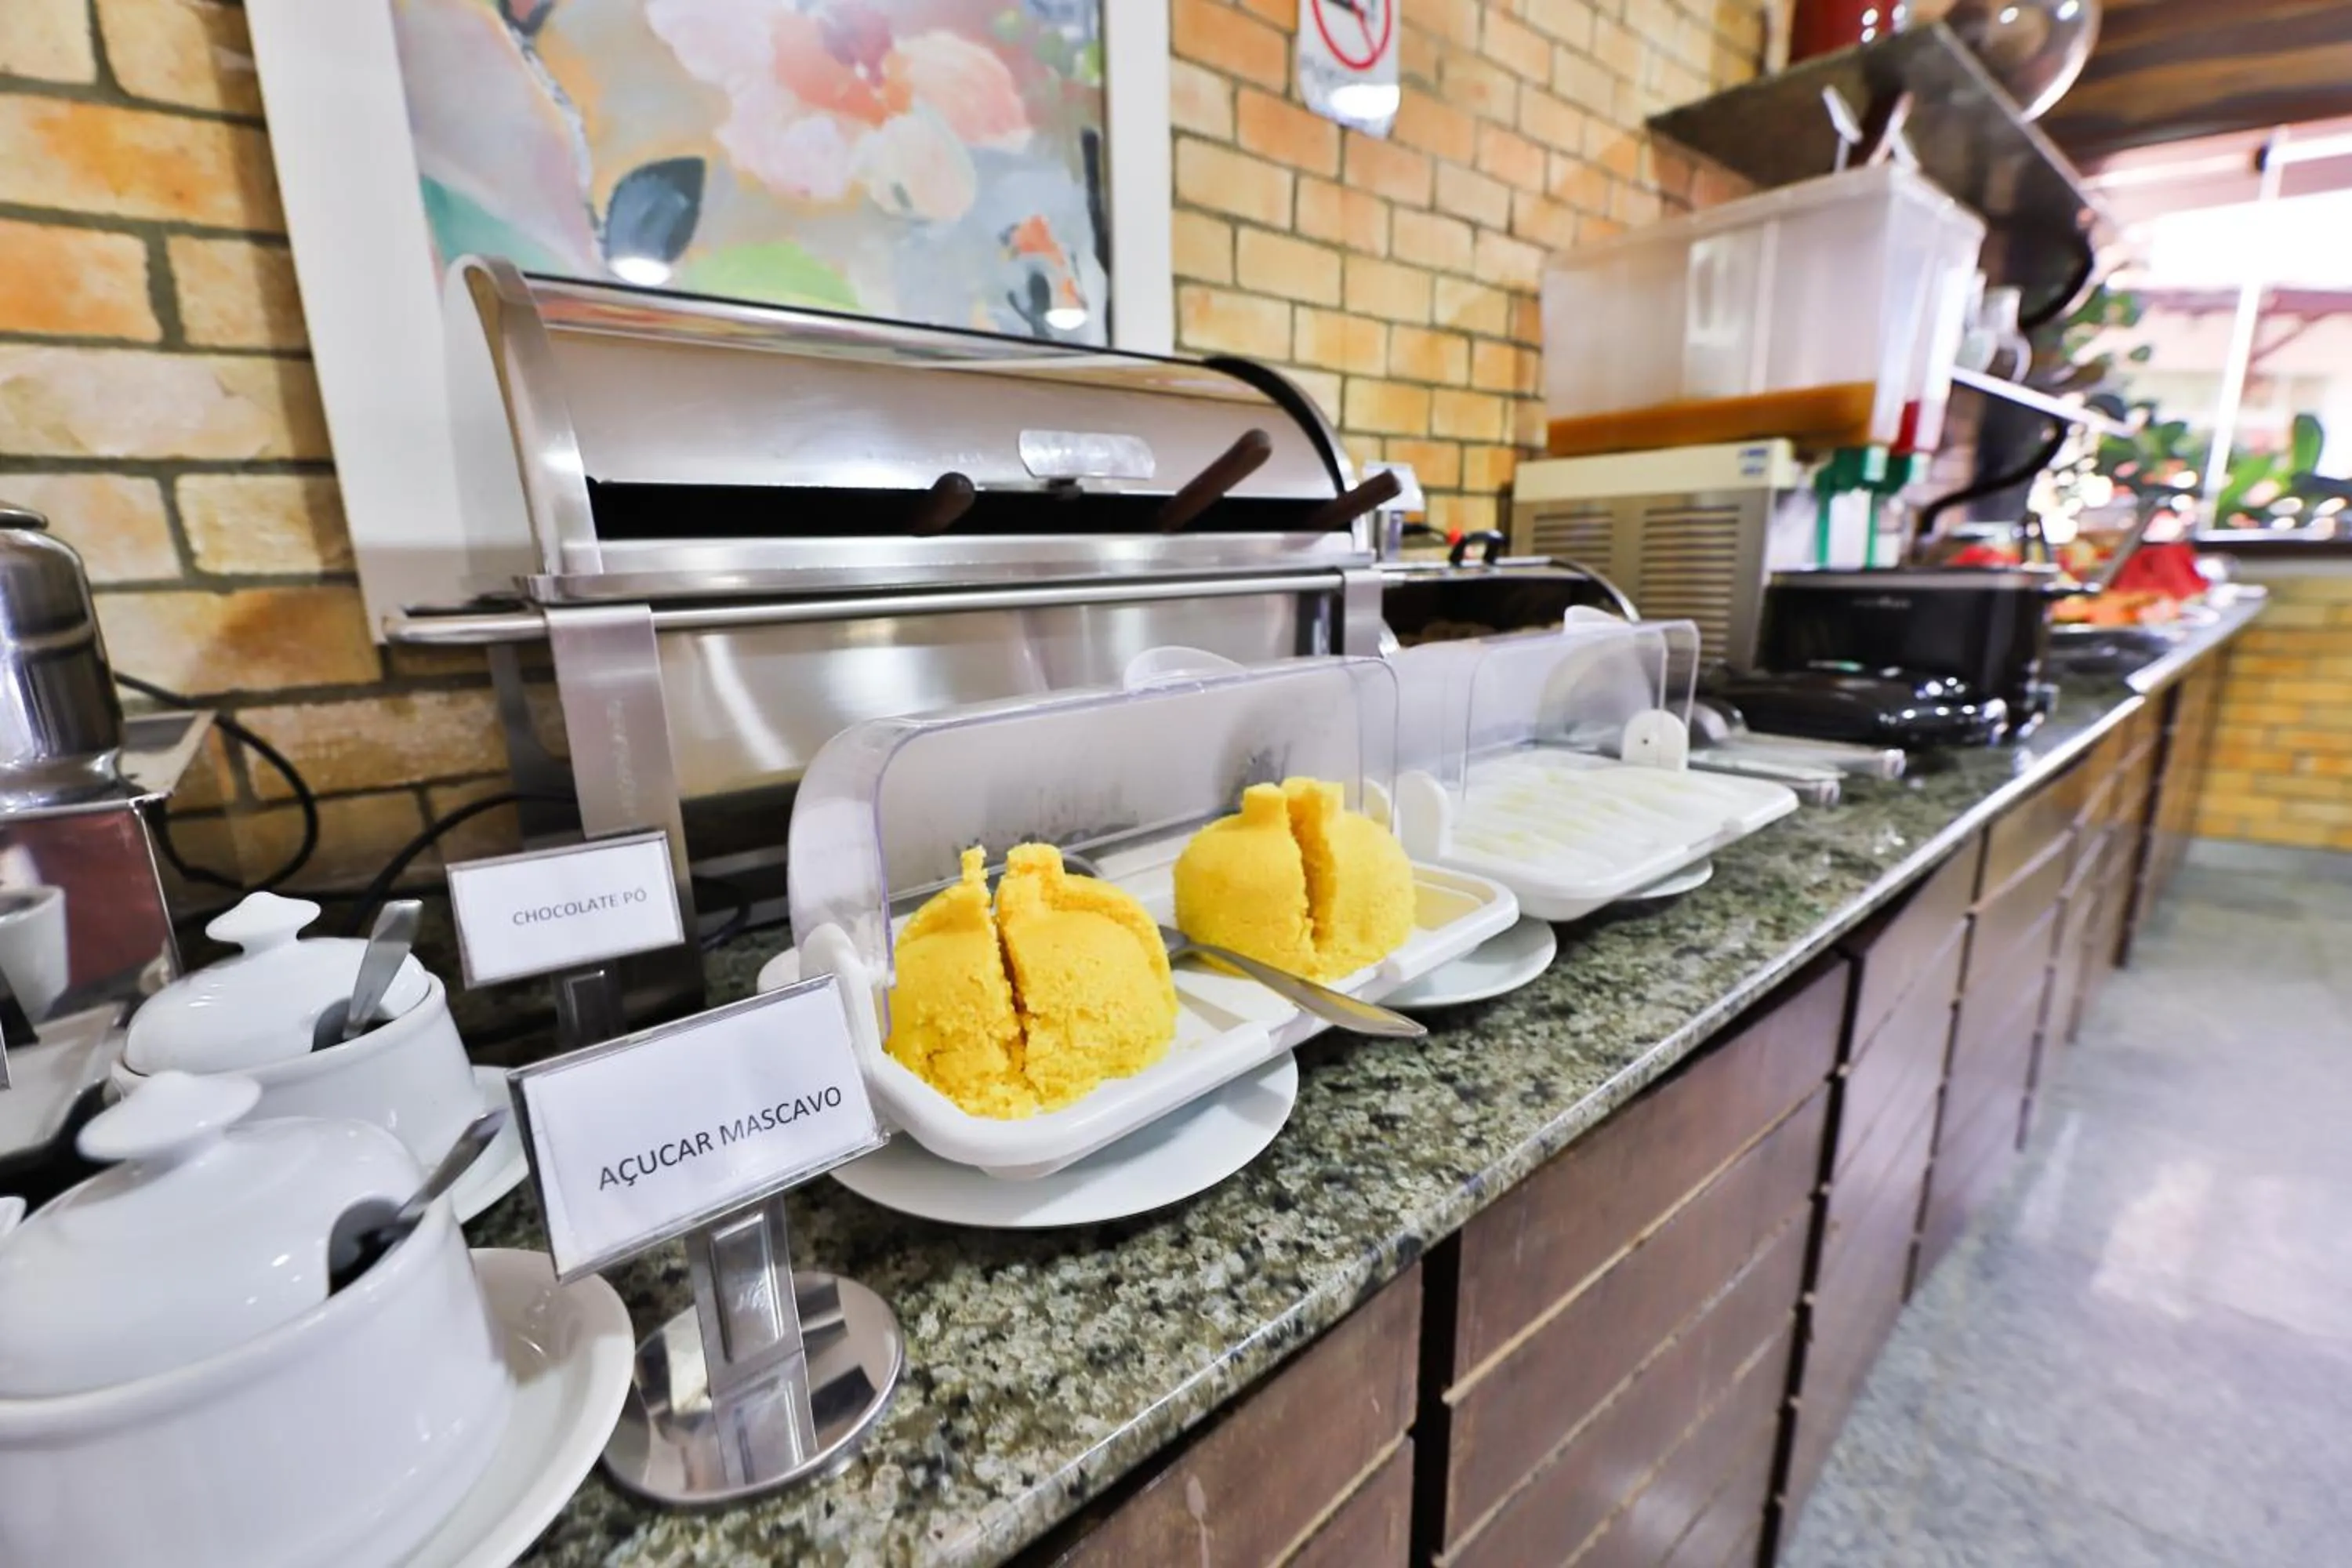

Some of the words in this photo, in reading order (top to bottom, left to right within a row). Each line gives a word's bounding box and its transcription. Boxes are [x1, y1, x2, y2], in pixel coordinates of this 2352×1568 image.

[512, 894, 618, 926] CHOCOLATE
[598, 1132, 714, 1191] AÇUCAR
[719, 1086, 842, 1146] MASCAVO
